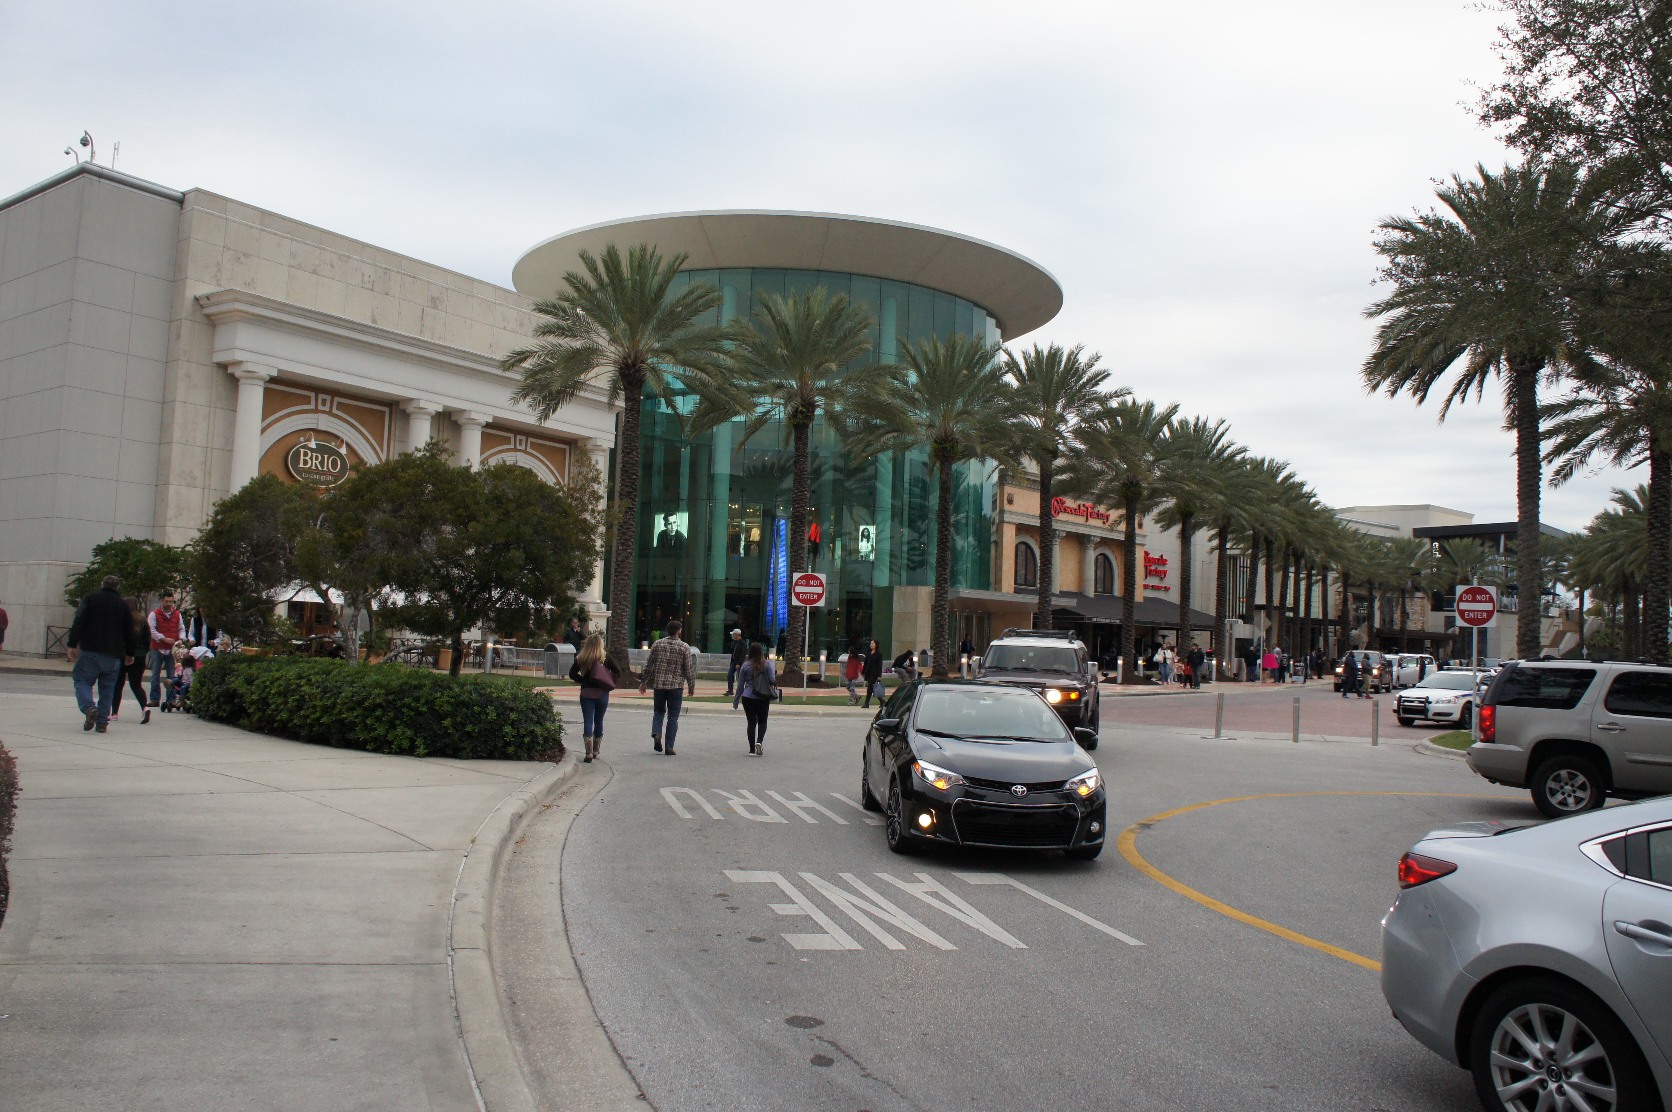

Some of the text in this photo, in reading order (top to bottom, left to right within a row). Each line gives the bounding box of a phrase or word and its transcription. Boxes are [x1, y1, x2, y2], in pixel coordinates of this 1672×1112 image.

[297, 448, 341, 473] BRIO
[1462, 593, 1473, 601] DO
[1464, 611, 1487, 619] ENTER
[722, 870, 1146, 951] LANE
